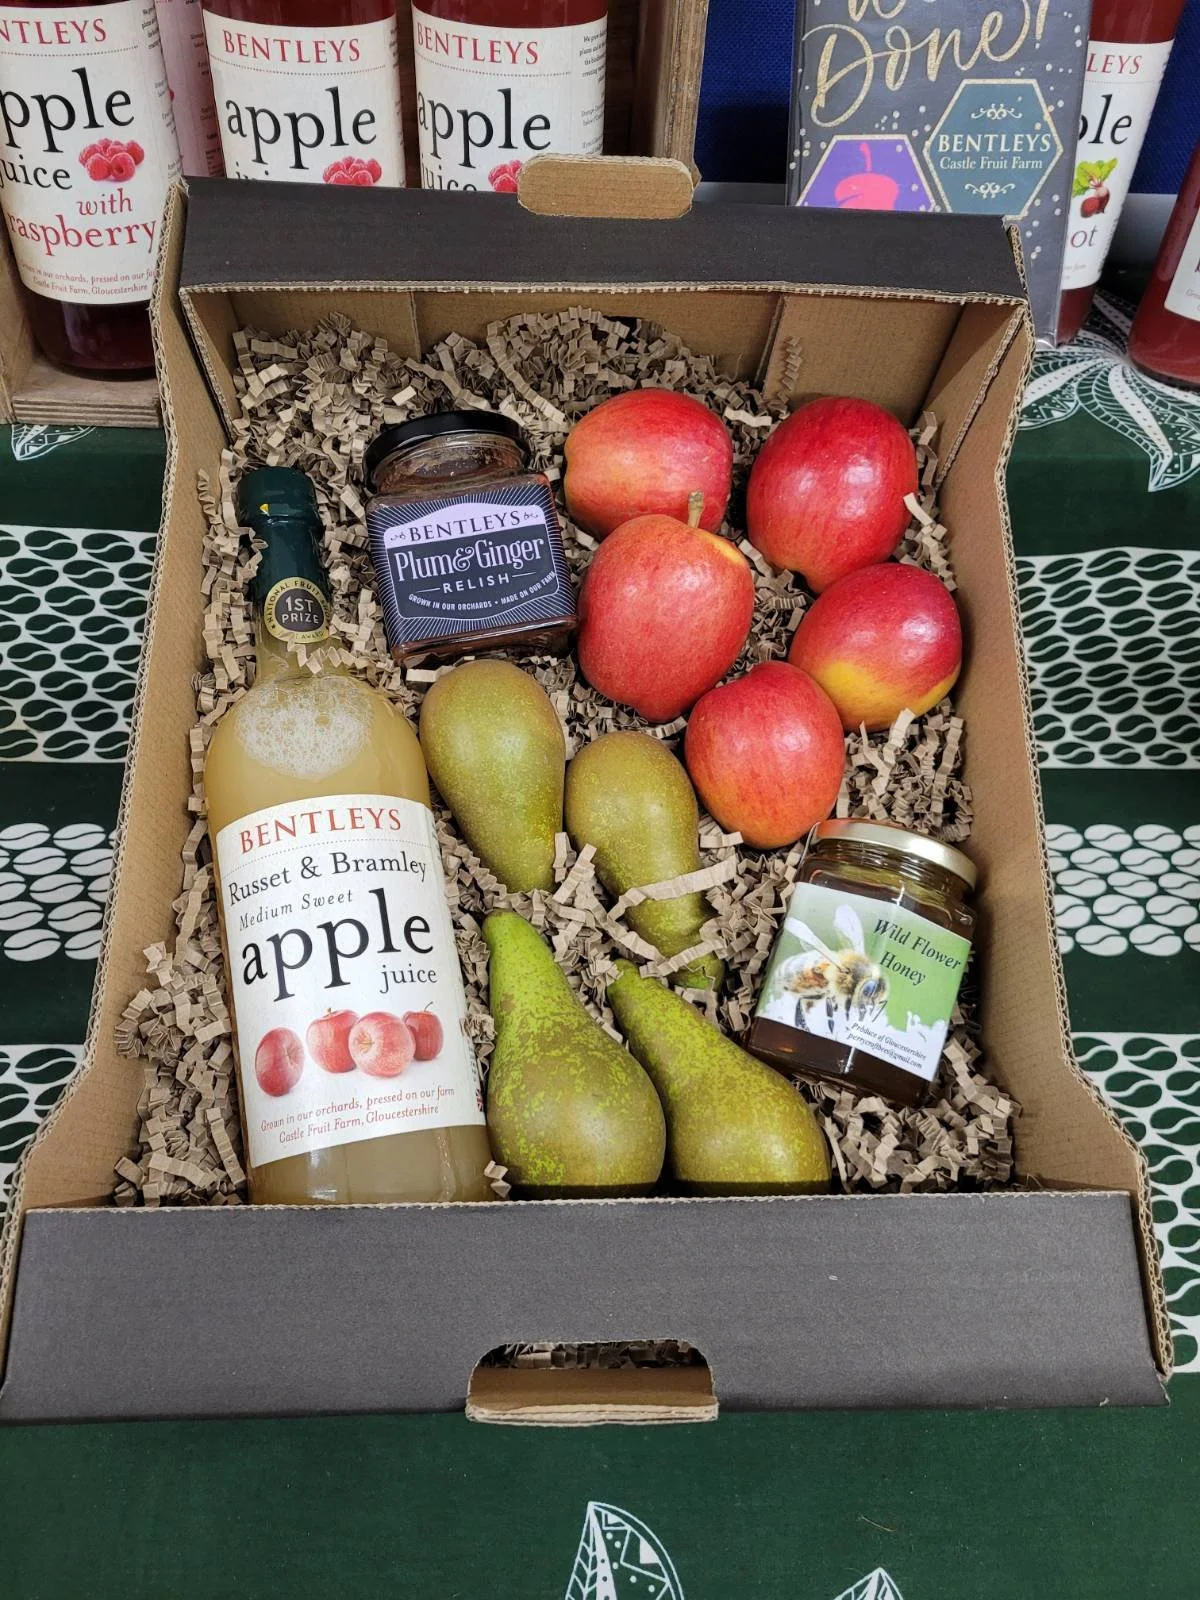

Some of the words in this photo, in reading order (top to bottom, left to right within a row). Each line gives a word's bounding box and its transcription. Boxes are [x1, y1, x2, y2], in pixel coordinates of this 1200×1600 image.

[222, 29, 361, 63] BENTLEYS
[417, 22, 539, 65] BENTLEYS
[1086, 53, 1142, 75] LEYS
[226, 87, 377, 170] apple
[417, 88, 551, 168] apple
[937, 134, 1052, 153] BENTLEYS
[939, 157, 976, 170] Castle
[979, 156, 1009, 170] Fruit
[1012, 157, 1043, 170] Farm
[77, 188, 132, 216] with
[8, 214, 157, 256] raspberry
[91, 272, 118, 285] pressed
[132, 271, 144, 280] our
[91, 283, 148, 295] Gloucestershire
[409, 511, 521, 542] BENTLEYS
[294, 580, 320, 596] FRUIT
[408, 593, 431, 607] GROWN
[432, 600, 440, 609] IN
[442, 602, 455, 610] OUR
[457, 600, 493, 611] ORCHARDS
[500, 594, 518, 605] MADE
[519, 589, 529, 599] ON
[528, 582, 542, 593] OUR
[443, 573, 510, 594] RELISH
[281, 613, 320, 624] PRIZE
[285, 595, 314, 612] 1ST
[239, 807, 401, 854] BENTLEYS
[228, 866, 292, 907] Russet
[300, 856, 322, 880] &
[329, 851, 427, 882] Bramley
[239, 902, 293, 931] Medium
[301, 889, 354, 910] Sweet
[242, 887, 434, 1002] apple
[873, 918, 912, 945] Wild
[911, 936, 962, 970] Flower
[379, 963, 438, 994] juice
[879, 951, 926, 986] Honey
[851, 1022, 878, 1038] Produce
[260, 1117, 285, 1132] Grown
[286, 1113, 295, 1123] in
[297, 1110, 313, 1121] our
[315, 1098, 362, 1118] orchards,
[366, 1090, 403, 1110] pressed
[405, 1091, 418, 1100] on
[420, 1088, 435, 1098] our
[437, 1085, 455, 1100] farm
[279, 1129, 305, 1144] Castle
[307, 1121, 331, 1136] Fruit
[334, 1116, 364, 1130] Farm,
[366, 1104, 439, 1124] Gloucestershire
